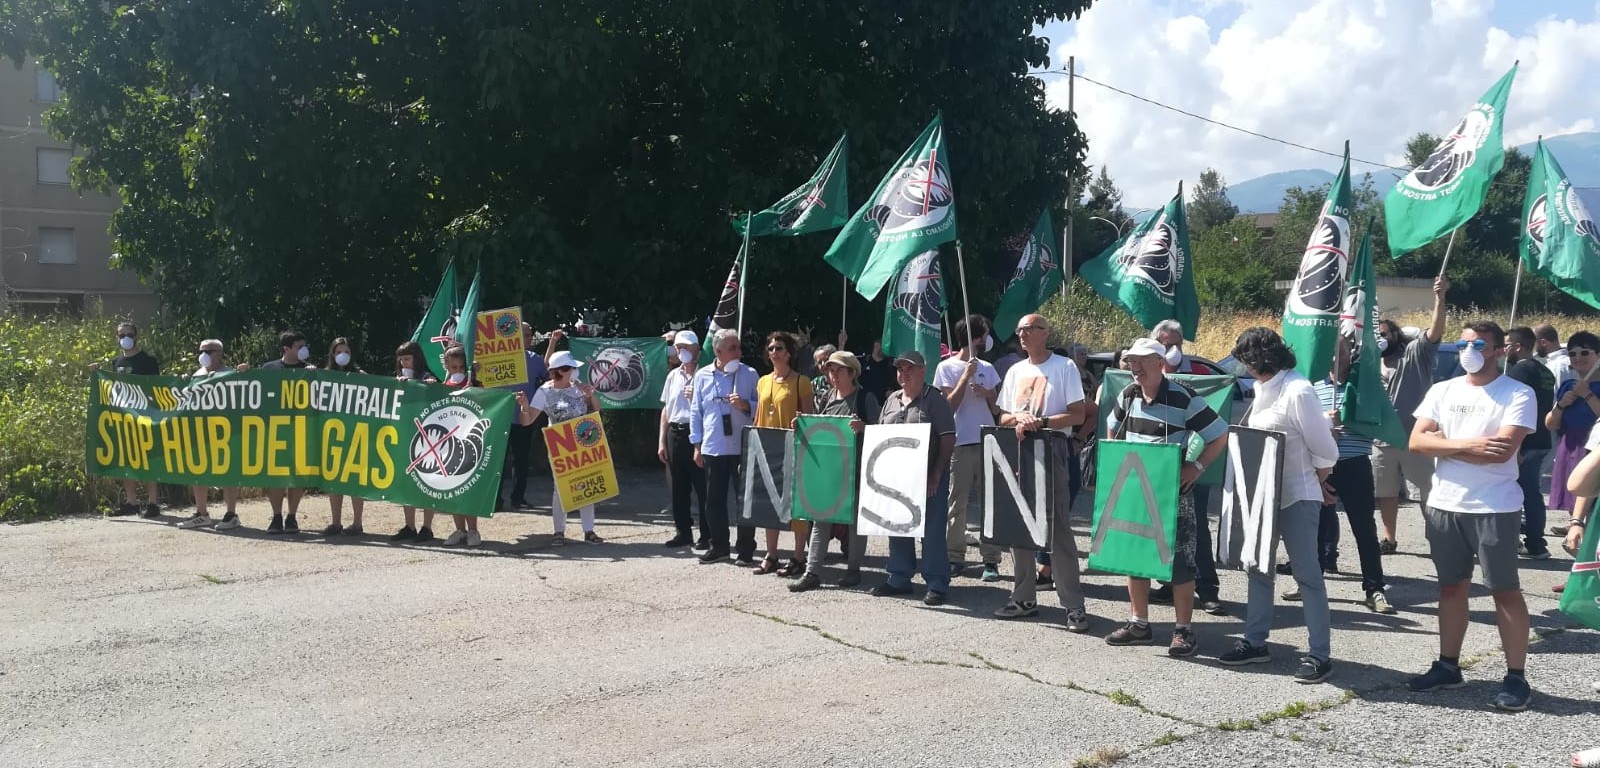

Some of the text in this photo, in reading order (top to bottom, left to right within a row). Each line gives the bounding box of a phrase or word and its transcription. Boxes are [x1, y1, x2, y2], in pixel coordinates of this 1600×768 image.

[1402, 190, 1438, 201] NOSTRA
[1335, 205, 1349, 214] NO
[475, 338, 520, 356] SNAM
[496, 370, 516, 381] GAS
[420, 397, 485, 419] NO RETE ADRIATICA
[96, 410, 153, 471] STOP
[160, 415, 231, 475] HUB
[553, 444, 607, 474] SNAM
[410, 471, 442, 499] DIFENDIAMO
[454, 474, 481, 497] NOSTRA
[481, 445, 492, 471] TERRA
[586, 475, 604, 487] HUB
[584, 483, 607, 498] GAS
